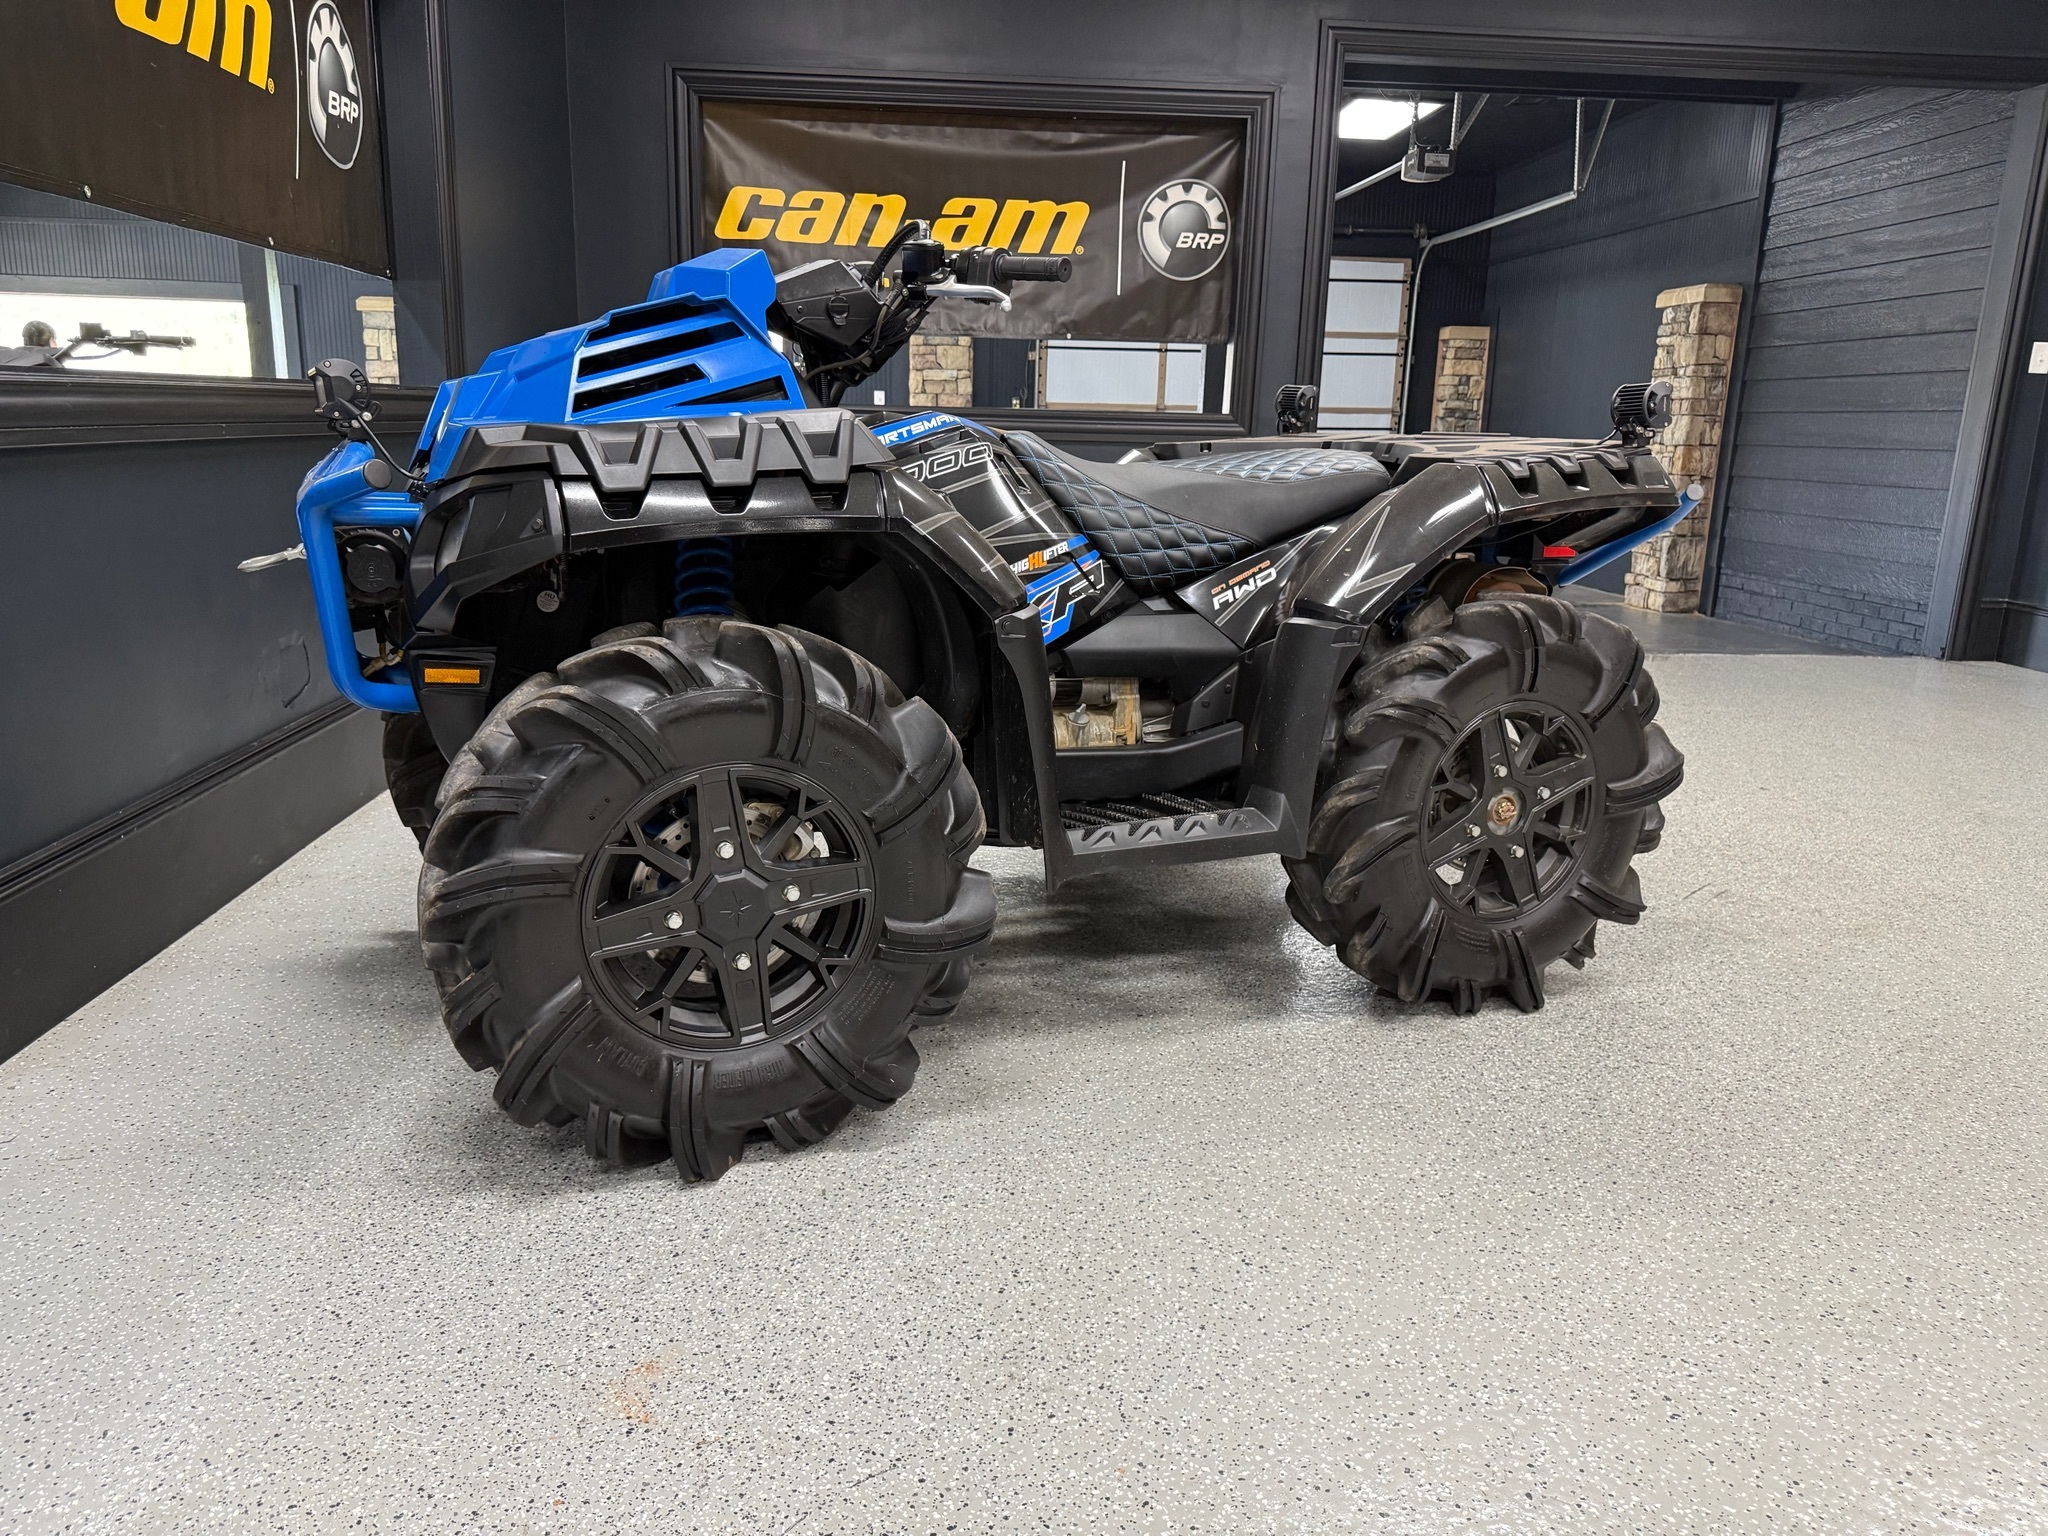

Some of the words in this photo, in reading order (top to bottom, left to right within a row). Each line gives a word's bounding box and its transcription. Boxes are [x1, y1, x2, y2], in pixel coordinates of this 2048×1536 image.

[328, 89, 359, 124] BRP
[1175, 231, 1225, 250] BRP
[1212, 567, 1277, 611] AWD
